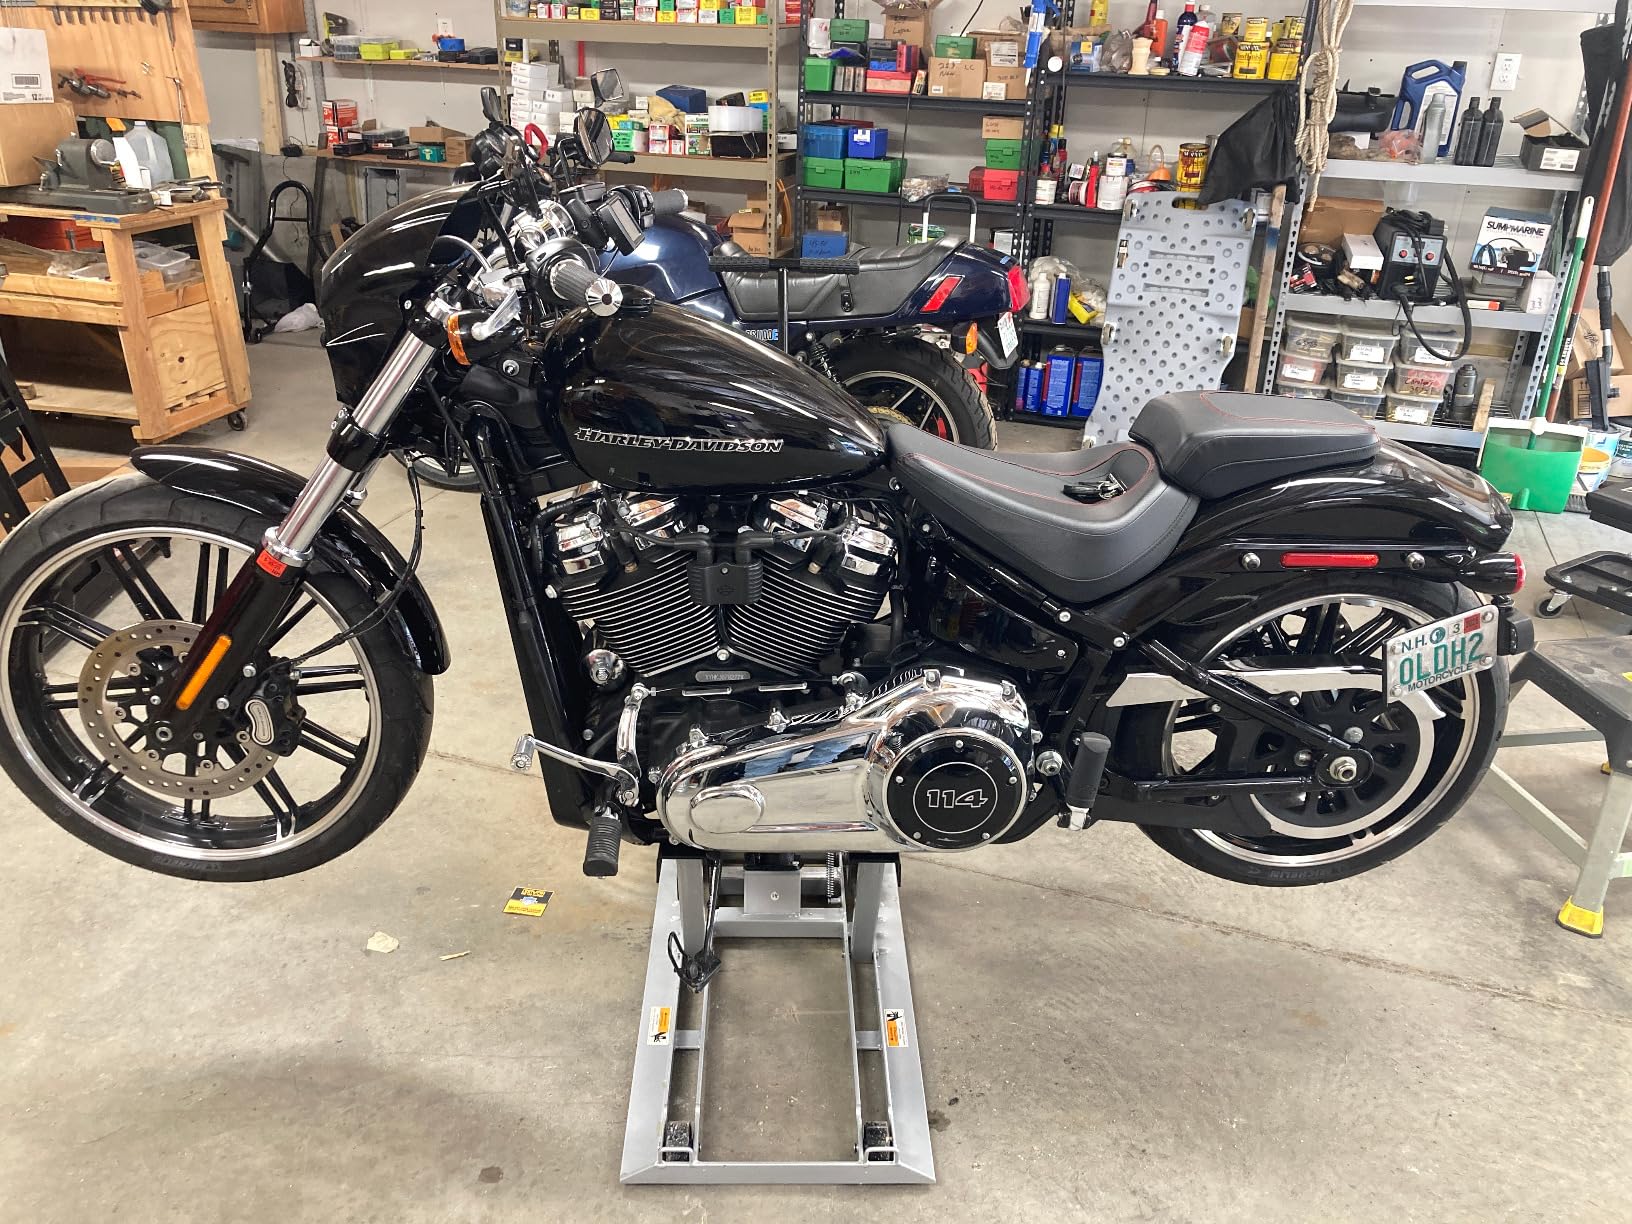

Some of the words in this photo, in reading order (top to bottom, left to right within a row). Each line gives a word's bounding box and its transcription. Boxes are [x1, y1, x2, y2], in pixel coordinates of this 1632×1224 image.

[574, 427, 784, 453] HARLEY-DAVIDSON
[1401, 635, 1428, 654] N.H.
[1407, 662, 1473, 692] MOTORCYCLE
[926, 788, 989, 809] 114
